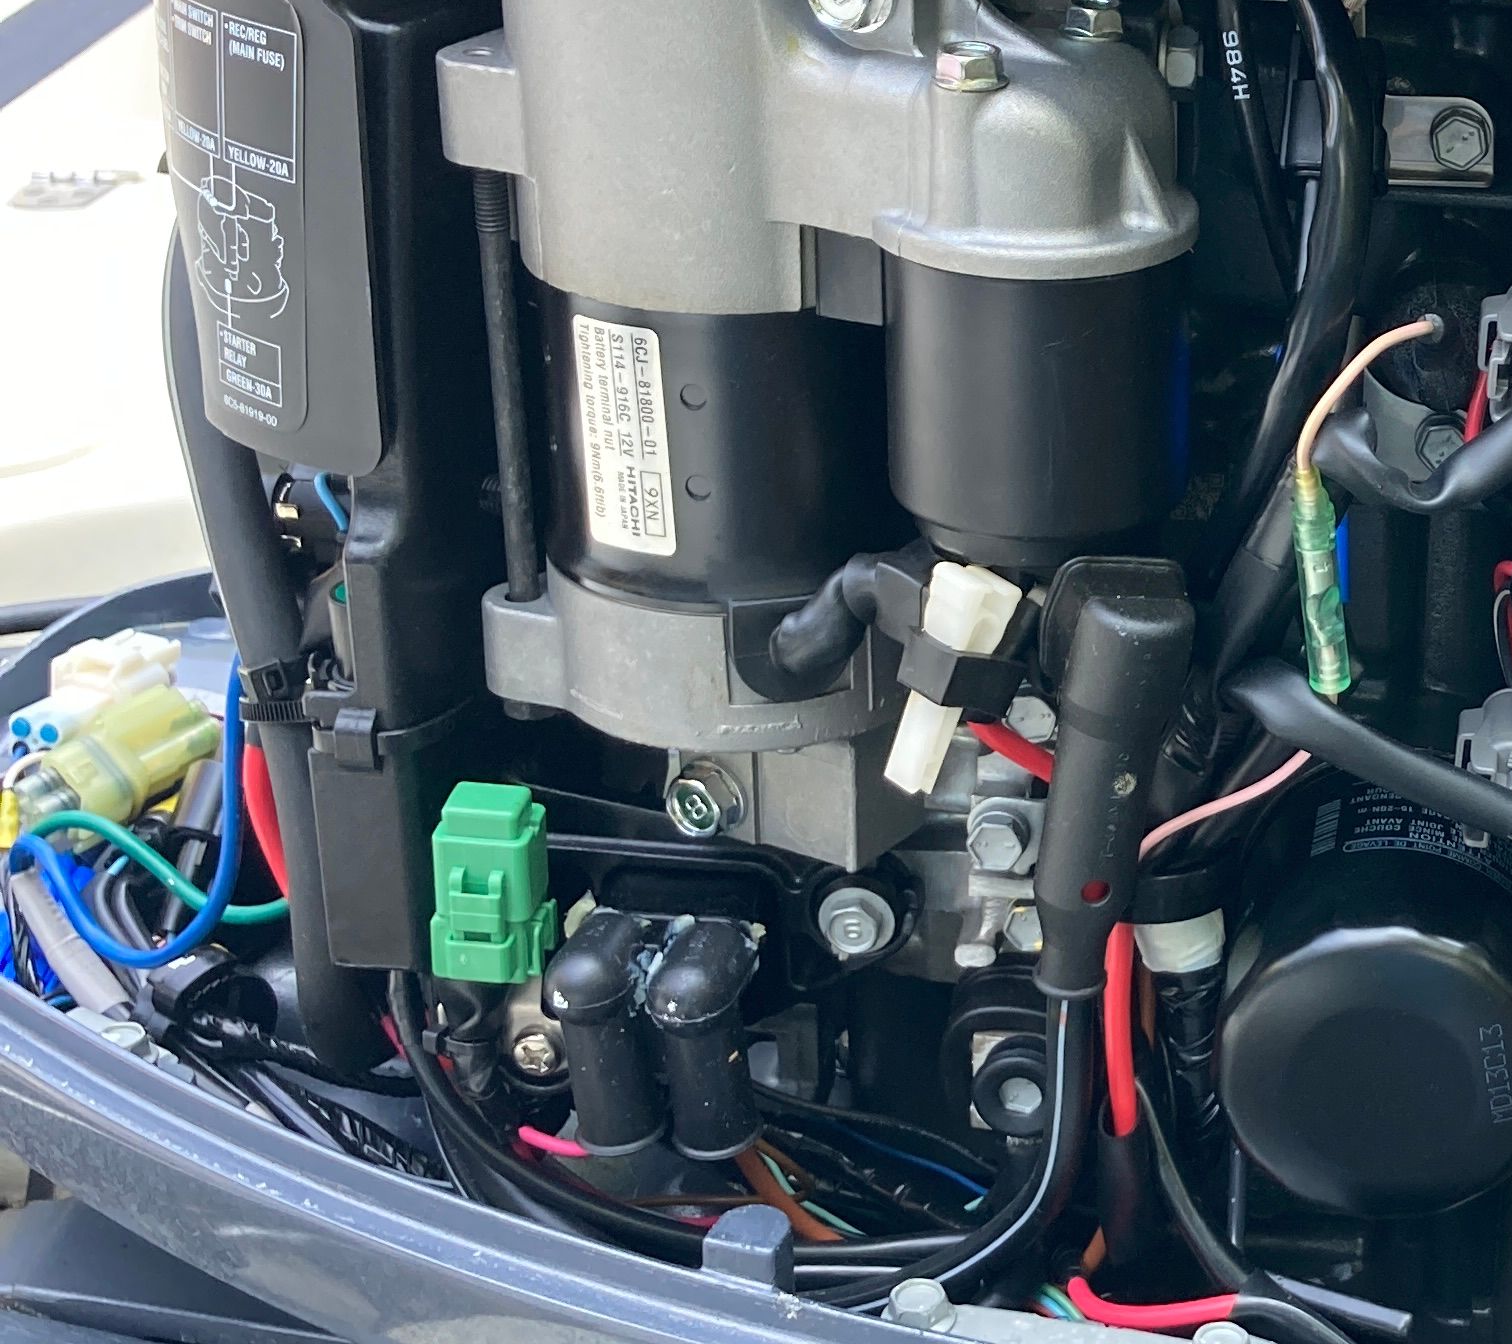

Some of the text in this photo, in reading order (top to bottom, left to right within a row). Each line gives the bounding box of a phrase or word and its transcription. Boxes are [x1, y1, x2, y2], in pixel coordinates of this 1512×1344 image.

[187, 3, 214, 29] SWITCH
[187, 21, 213, 46] SWITCH
[228, 22, 267, 46] REC/REG
[229, 39, 285, 72] (MAIN FUSE)
[1223, 30, 1251, 101] 984H
[228, 145, 289, 178] YELLOW-20A
[223, 329, 257, 357] STARTER
[223, 346, 248, 369] RELAY
[578, 323, 593, 390] Tightening
[226, 368, 273, 401] GREEN-30A
[594, 326, 616, 451] Battery terminal nut
[612, 333, 635, 458] S114-916C 12V
[634, 337, 658, 456] 6CJ-81800-01
[585, 394, 598, 439] torque:
[626, 466, 641, 537] HITACHI
[644, 487, 660, 521] 9XN
[1364, 817, 1404, 826] AVANT
